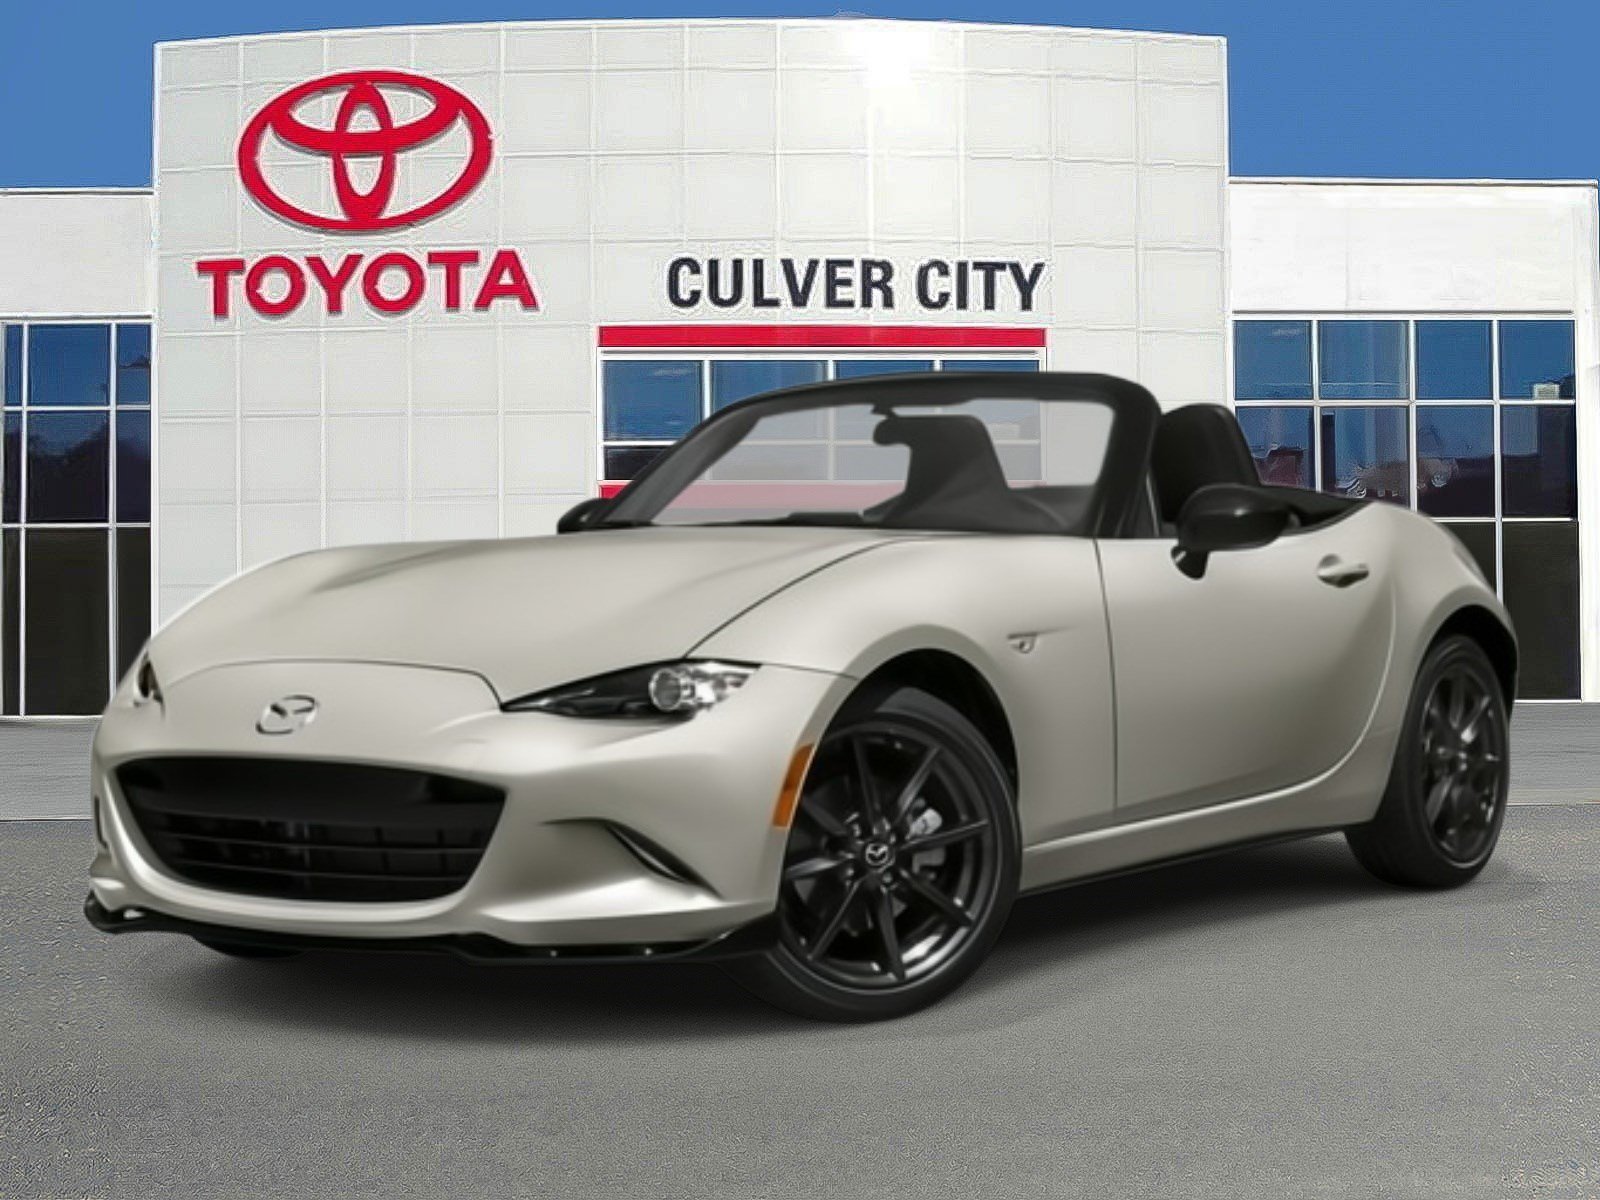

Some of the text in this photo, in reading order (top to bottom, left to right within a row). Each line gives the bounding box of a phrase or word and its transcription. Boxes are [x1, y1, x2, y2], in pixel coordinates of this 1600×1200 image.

[197, 249, 539, 319] TOYOTA
[667, 256, 1046, 311] CULVER CITY
